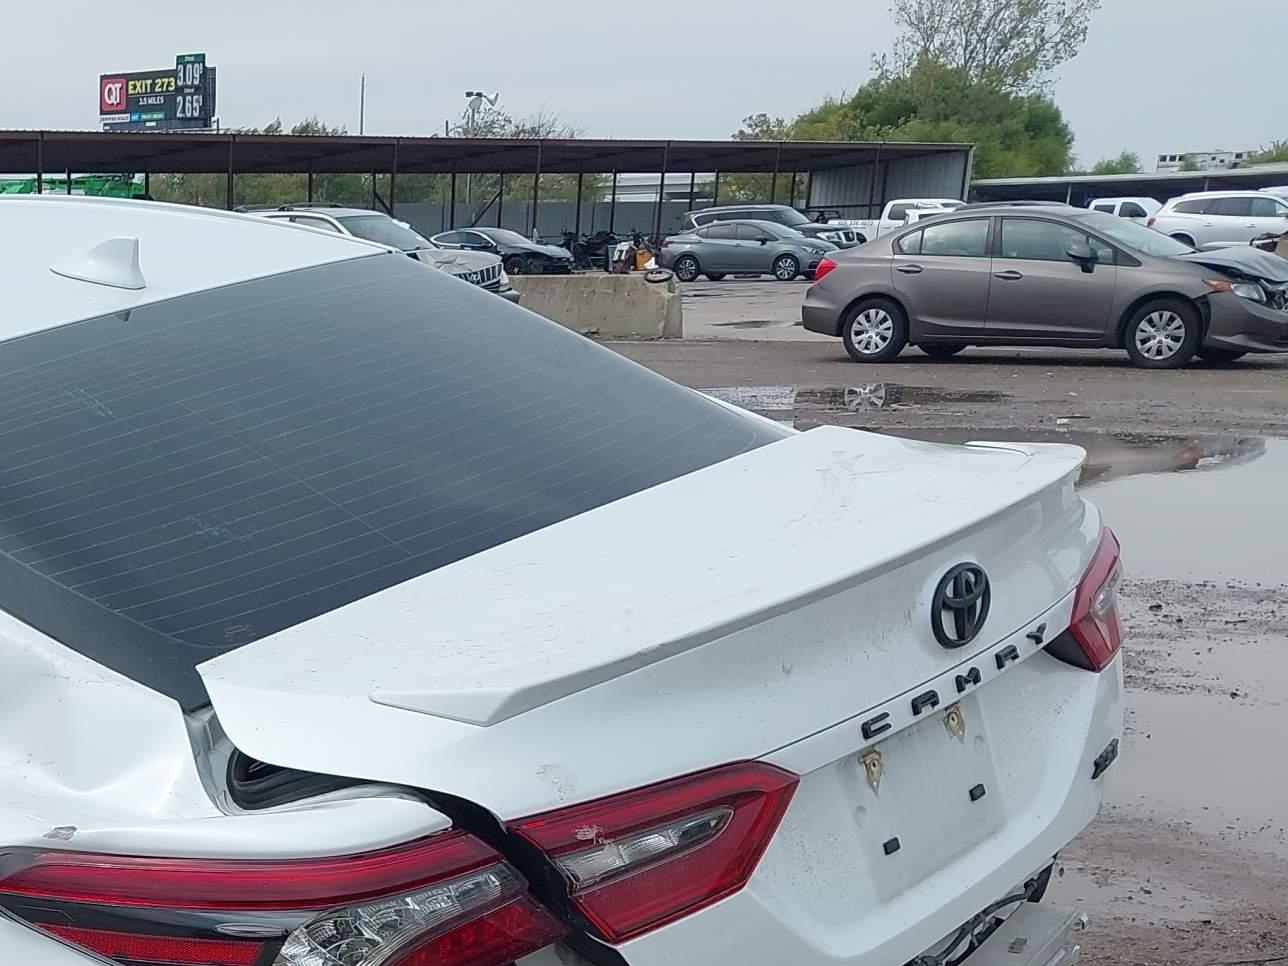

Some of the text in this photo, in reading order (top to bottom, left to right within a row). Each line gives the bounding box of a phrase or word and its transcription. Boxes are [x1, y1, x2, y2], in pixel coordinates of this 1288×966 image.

[104, 83, 122, 107] QT
[128, 77, 176, 94] EXIT 273
[861, 622, 1047, 740] CAMRY
